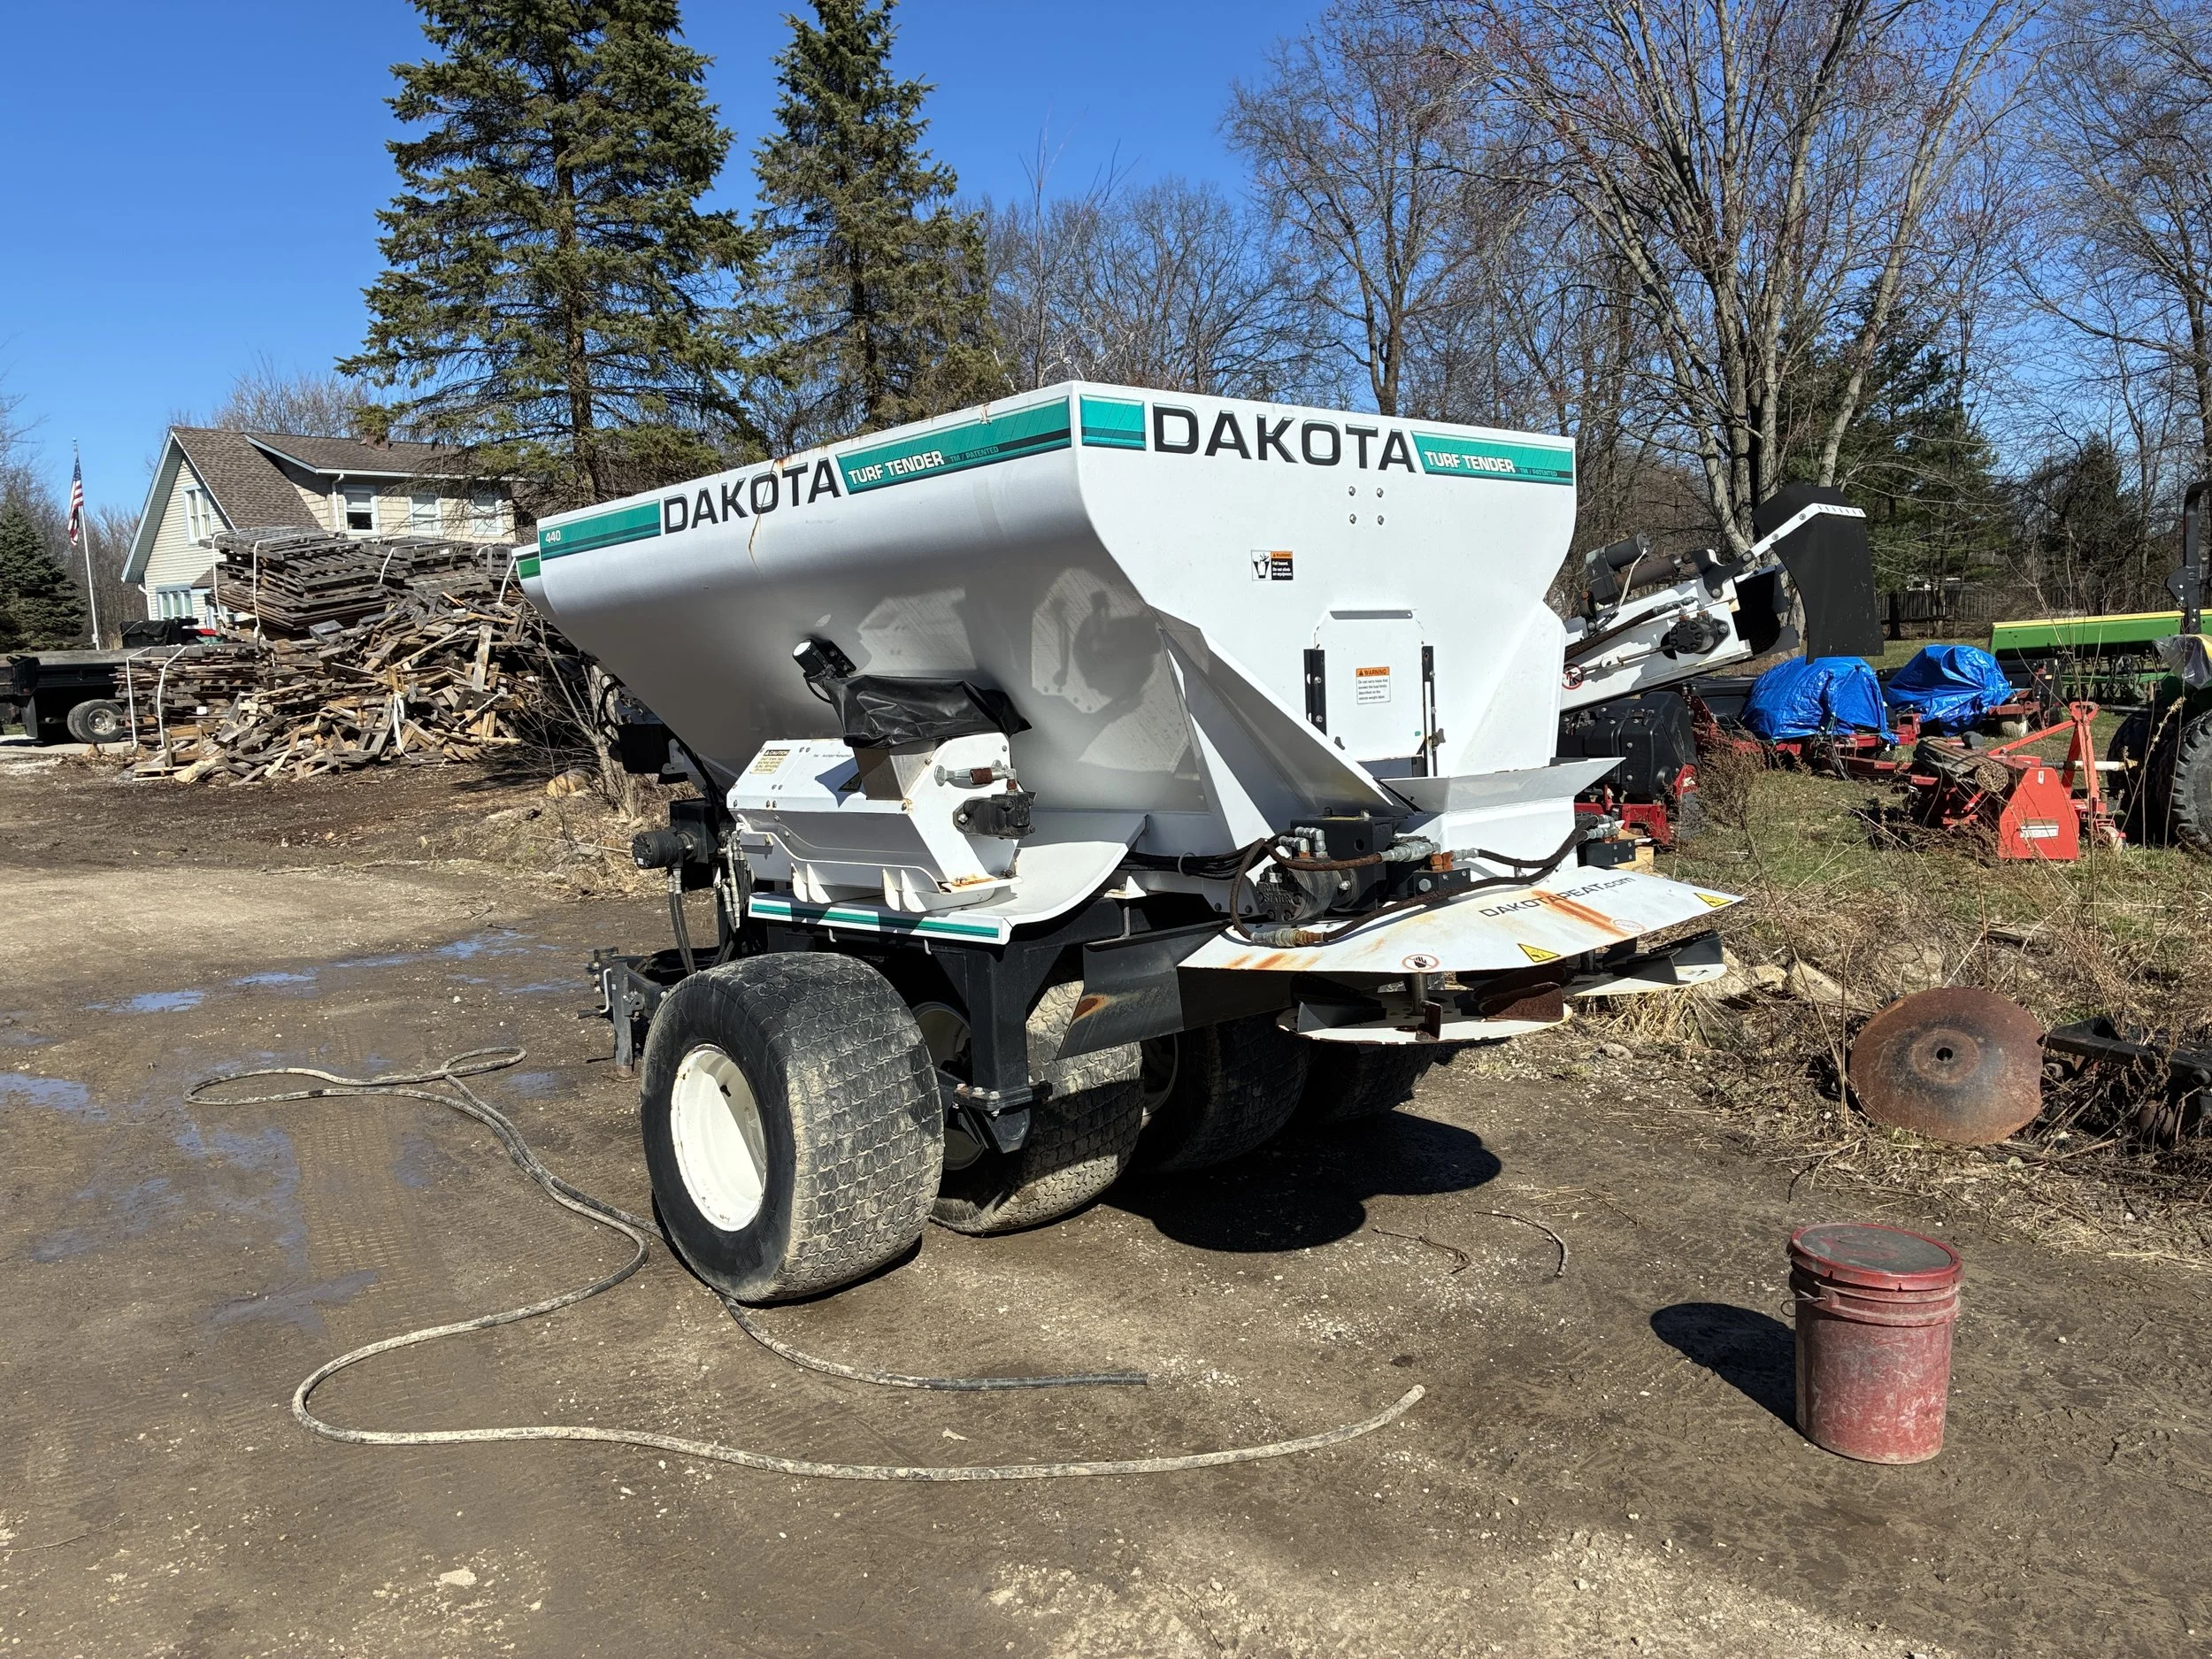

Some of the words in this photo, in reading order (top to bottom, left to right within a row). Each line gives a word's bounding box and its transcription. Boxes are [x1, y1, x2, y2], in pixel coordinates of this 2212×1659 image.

[1152, 402, 1417, 473] DAKOTA
[848, 464, 884, 485] TURF
[885, 449, 946, 477] TENDER
[949, 454, 961, 463] TM
[966, 446, 1000, 459] PATENTED
[1425, 450, 1461, 469] TURF
[1462, 455, 1517, 473] TENDER
[1532, 468, 1558, 478] PATENTED
[664, 457, 841, 534] DAKOTA
[545, 529, 562, 544] 440
[1479, 876, 1636, 918] DAKOTAPEAT.com
